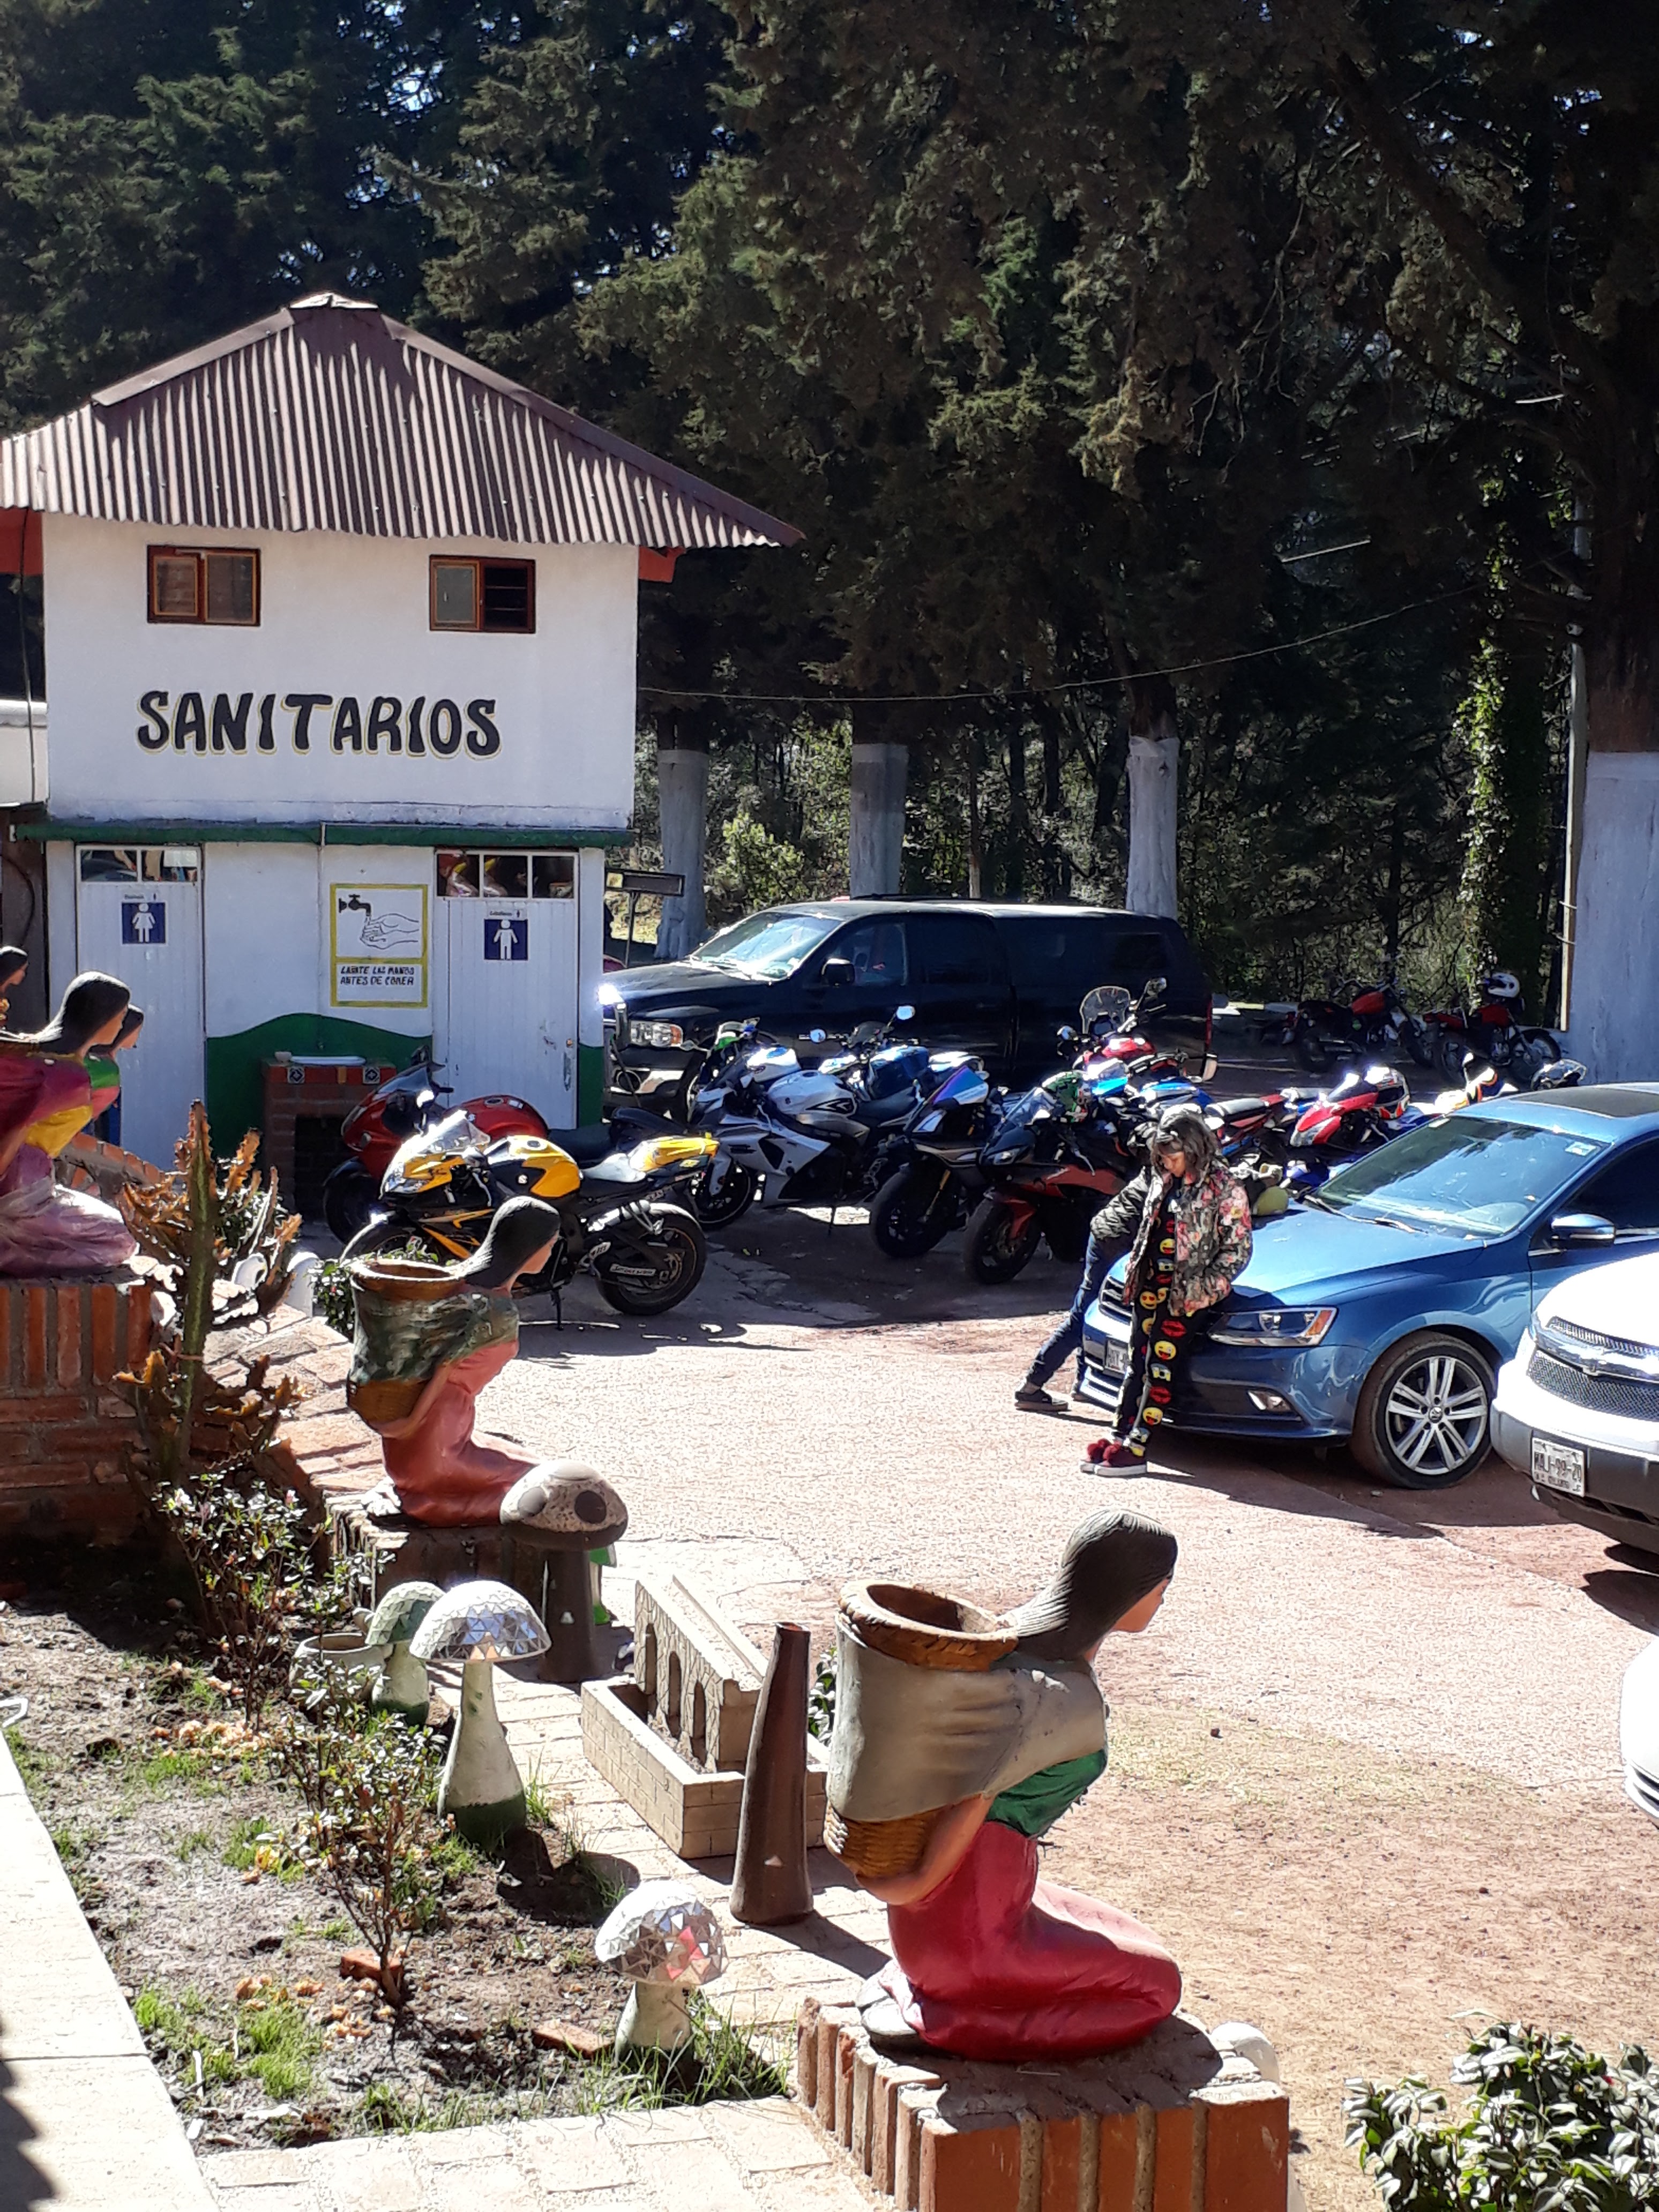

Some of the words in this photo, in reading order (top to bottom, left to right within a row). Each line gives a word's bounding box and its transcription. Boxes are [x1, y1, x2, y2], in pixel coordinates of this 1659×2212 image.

[137, 691, 501, 758] SANITARIOS
[372, 966, 385, 974] LAS
[388, 967, 414, 975] MANOS
[340, 976, 368, 985] ANTES
[370, 976, 382, 985] DE
[385, 976, 414, 985] COMER
